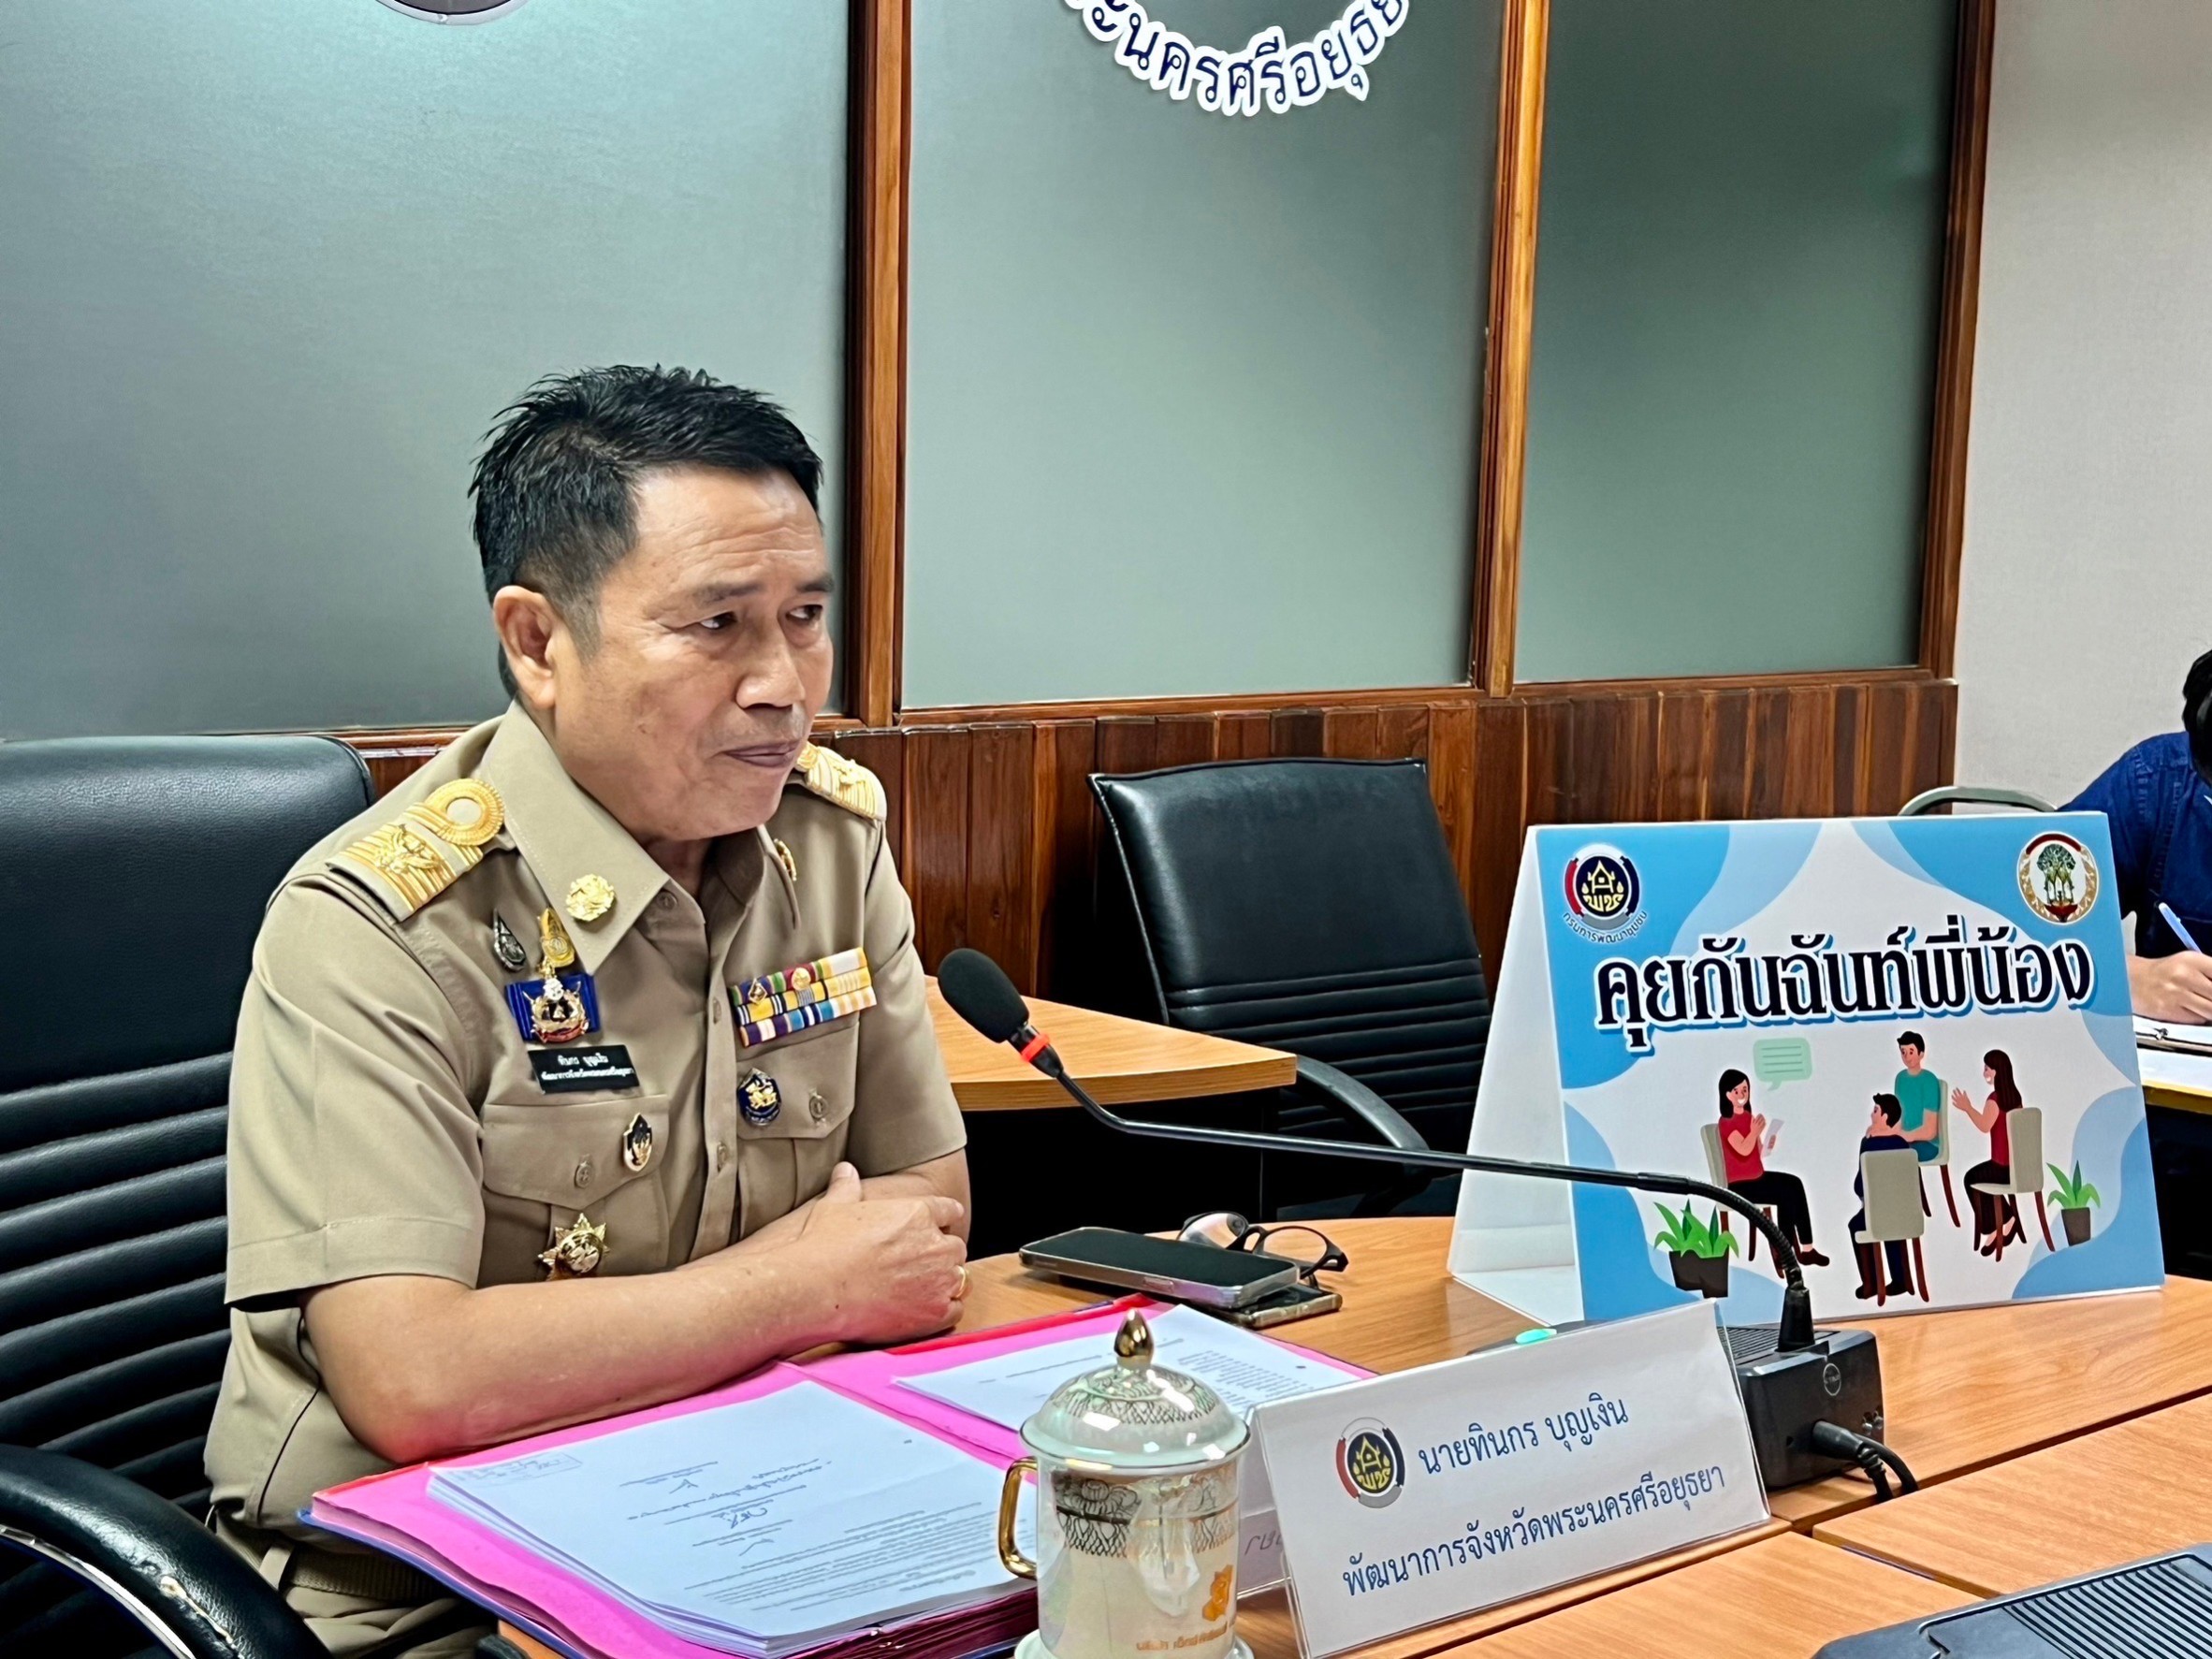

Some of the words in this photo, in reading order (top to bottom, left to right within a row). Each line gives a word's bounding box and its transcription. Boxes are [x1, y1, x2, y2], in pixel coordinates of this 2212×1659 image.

[1563, 911, 1648, 944] กรมการพฒนาชุมชน
[1597, 914, 2091, 1048] คุยกันฉันท์พี่น้อง
[1418, 1421, 1540, 1475] นายทินกร
[1544, 1391, 1629, 1452] บุญเงิน
[1342, 1465, 1725, 1596] พัฒนาการจังหวัดพระนครศรีอยุธยา
